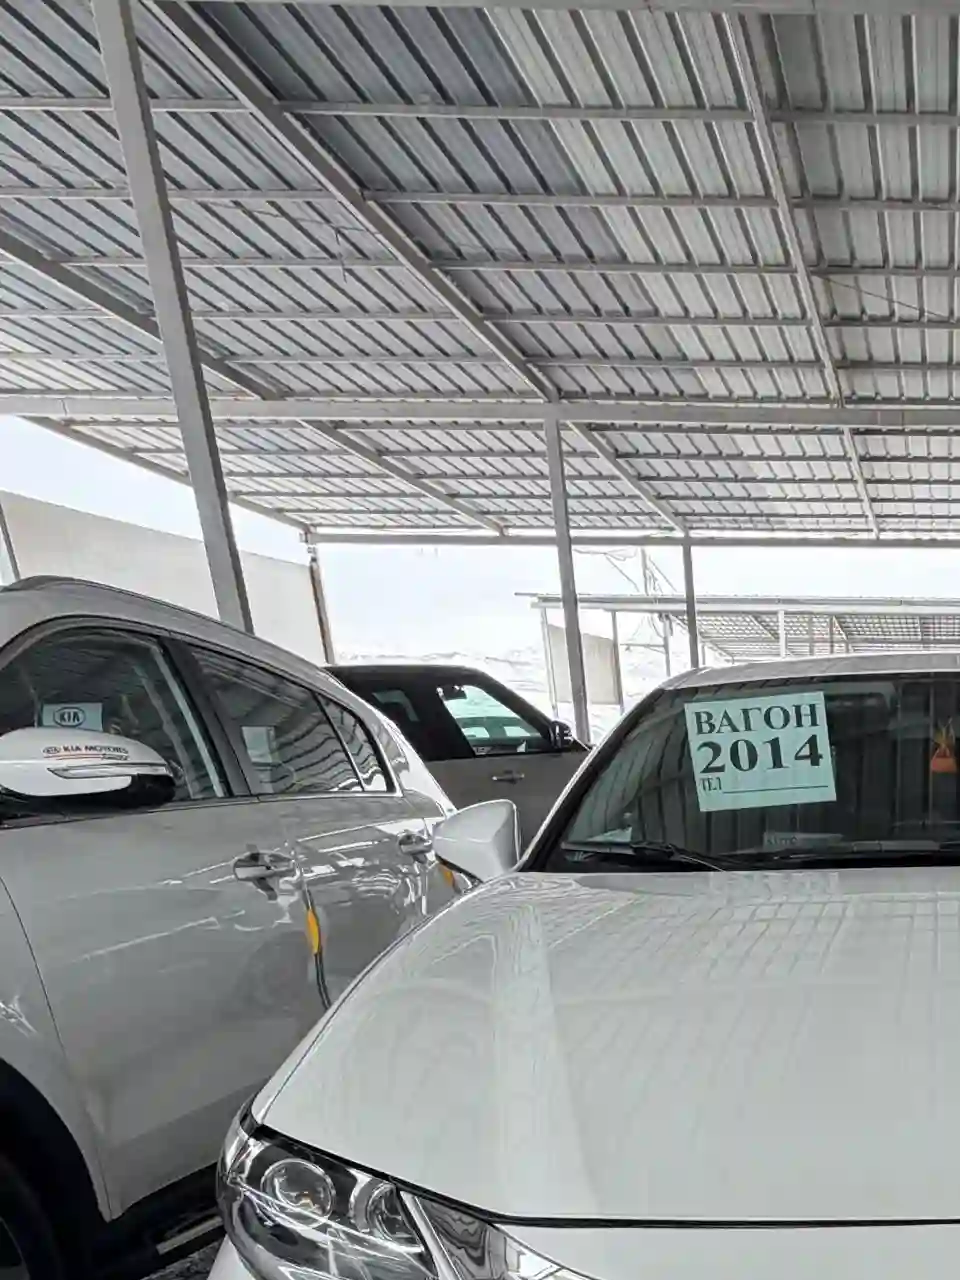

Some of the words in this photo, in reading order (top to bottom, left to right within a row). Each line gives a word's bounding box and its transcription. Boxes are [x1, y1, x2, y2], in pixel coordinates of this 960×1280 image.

[59, 710, 81, 723] KIA
[694, 703, 820, 735] ВАГОН
[84, 745, 129, 754] MOTORS
[697, 734, 823, 774] 2014
